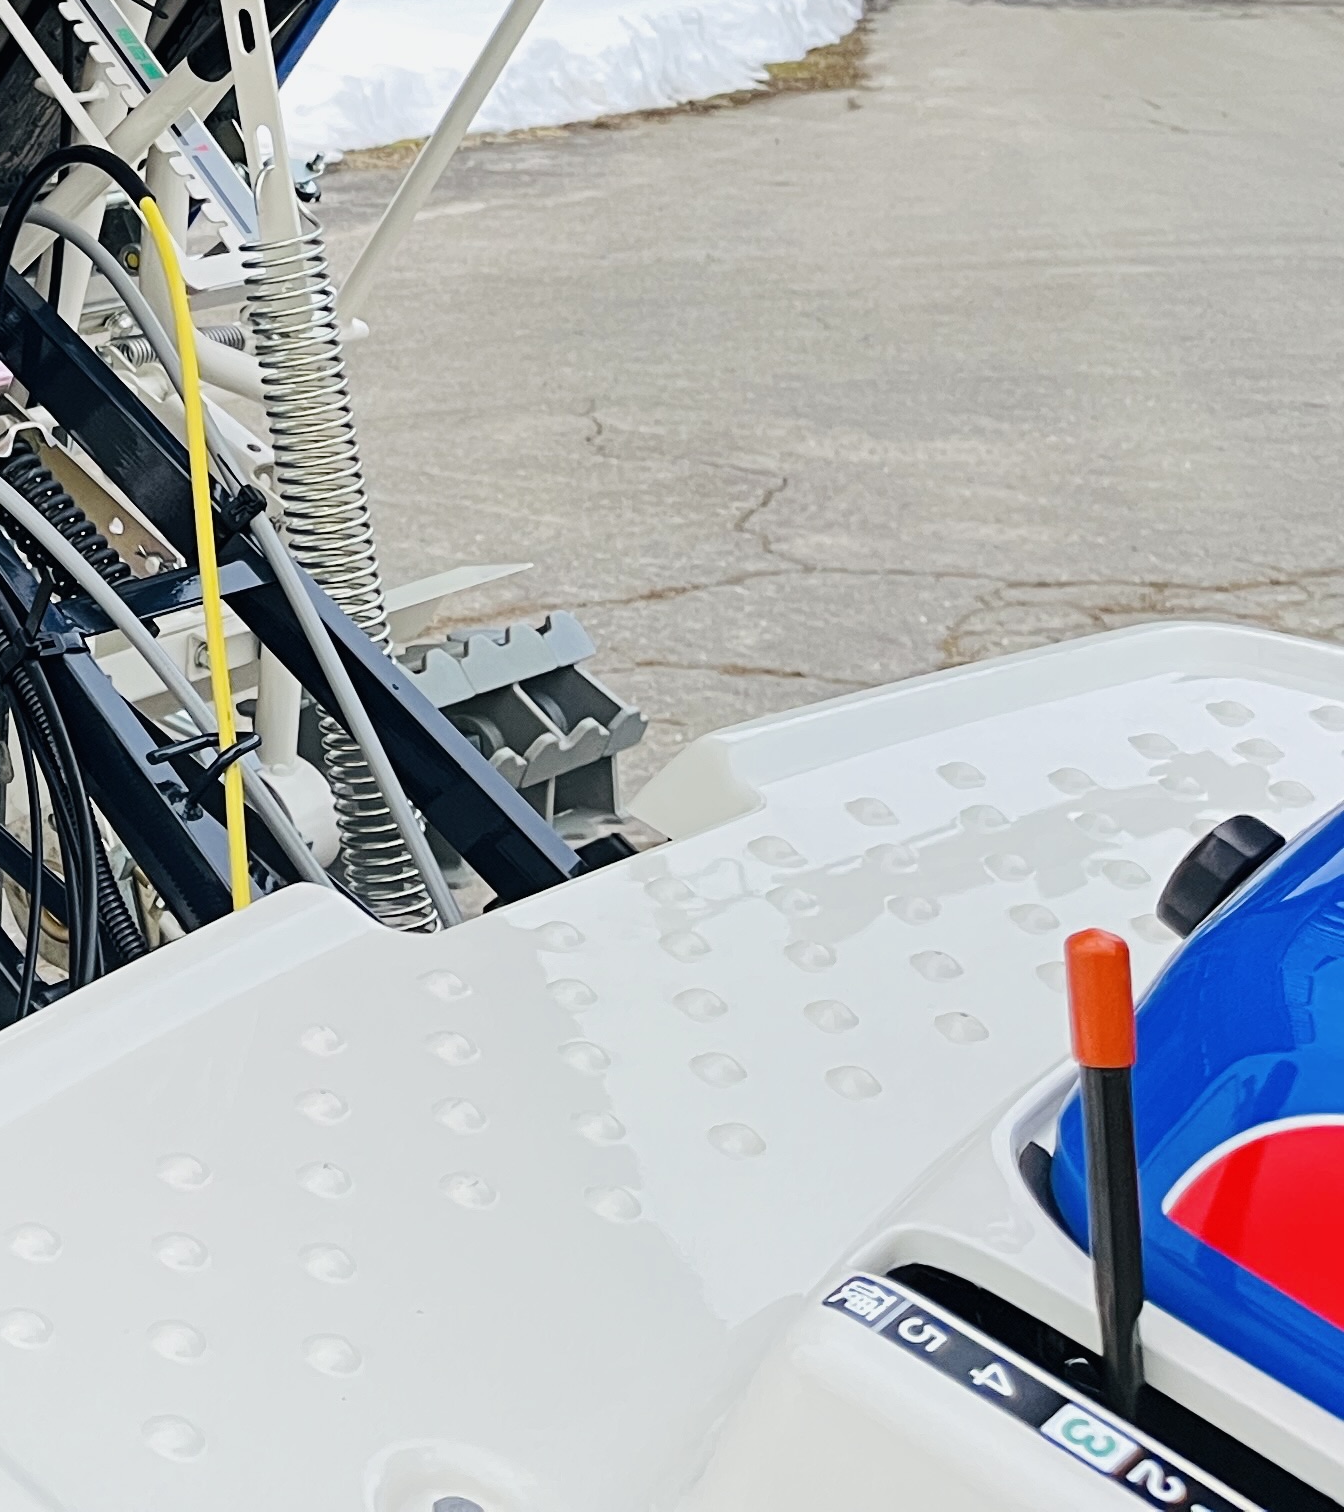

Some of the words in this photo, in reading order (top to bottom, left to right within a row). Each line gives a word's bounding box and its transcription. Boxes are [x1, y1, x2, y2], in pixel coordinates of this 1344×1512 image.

[897, 1316, 948, 1352] 5
[969, 1362, 1013, 1397] 4
[1061, 1418, 1116, 1458] 3
[1125, 1459, 1187, 1504] 2
